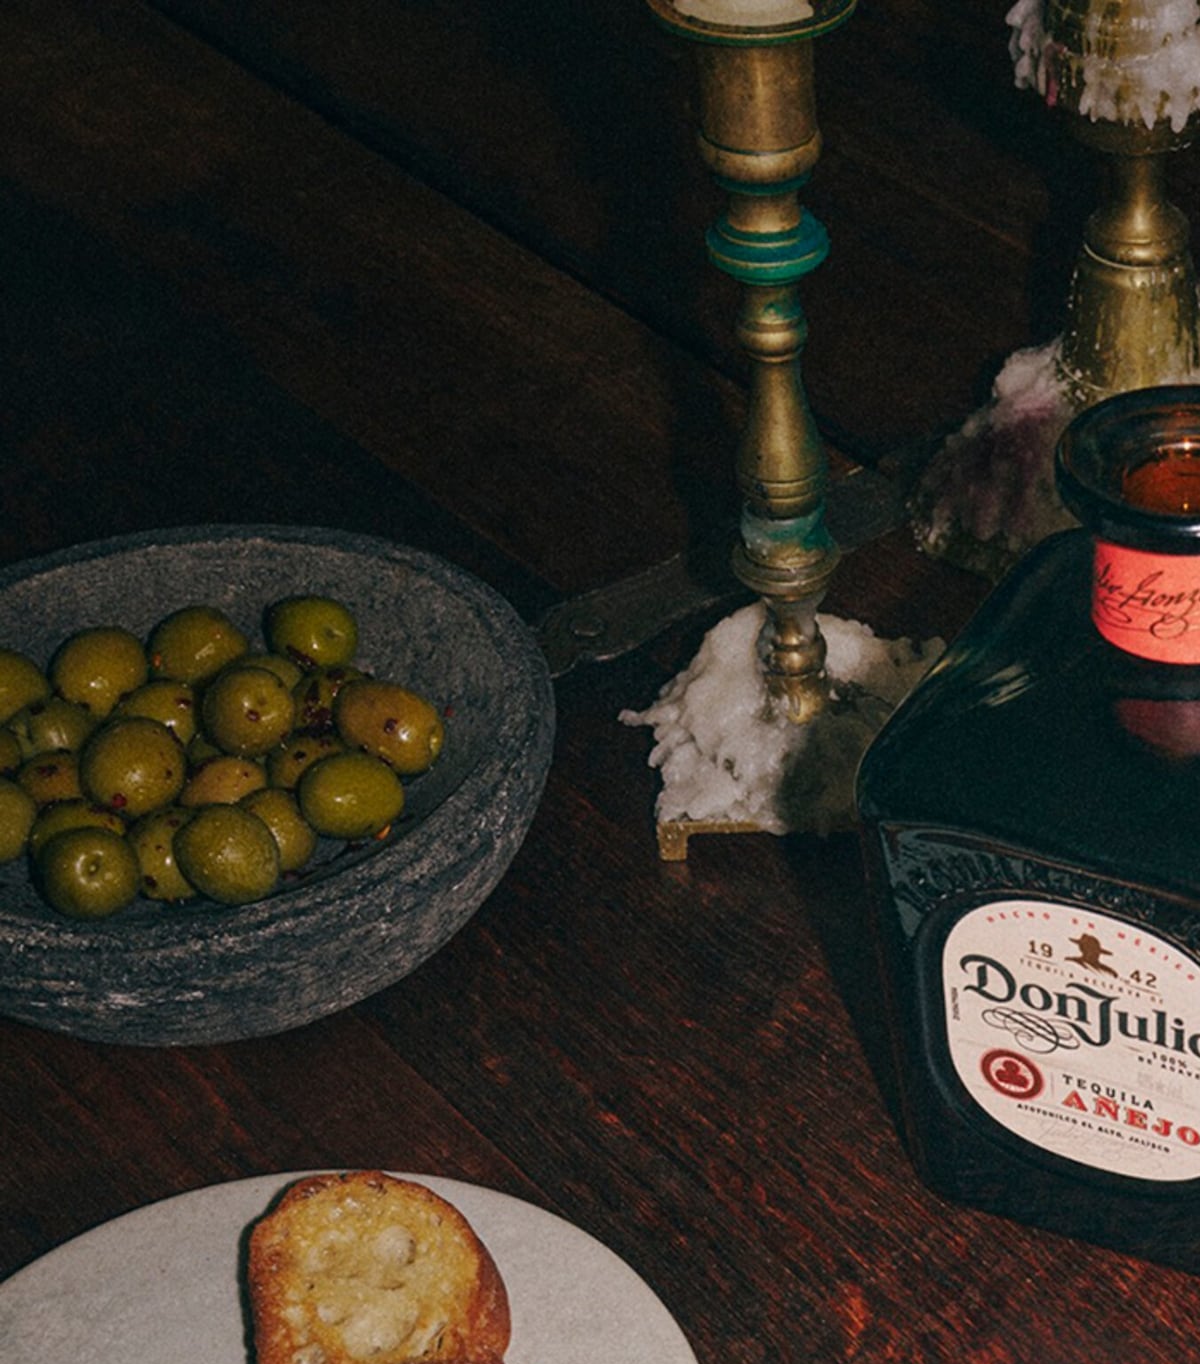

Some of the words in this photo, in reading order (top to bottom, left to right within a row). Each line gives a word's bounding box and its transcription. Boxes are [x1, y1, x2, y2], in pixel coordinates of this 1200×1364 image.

[1028, 939, 1053, 958] 19
[1129, 969, 1157, 989] 42
[1152, 1051, 1187, 1068] 100%
[1062, 1074, 1154, 1111] TEQUILA
